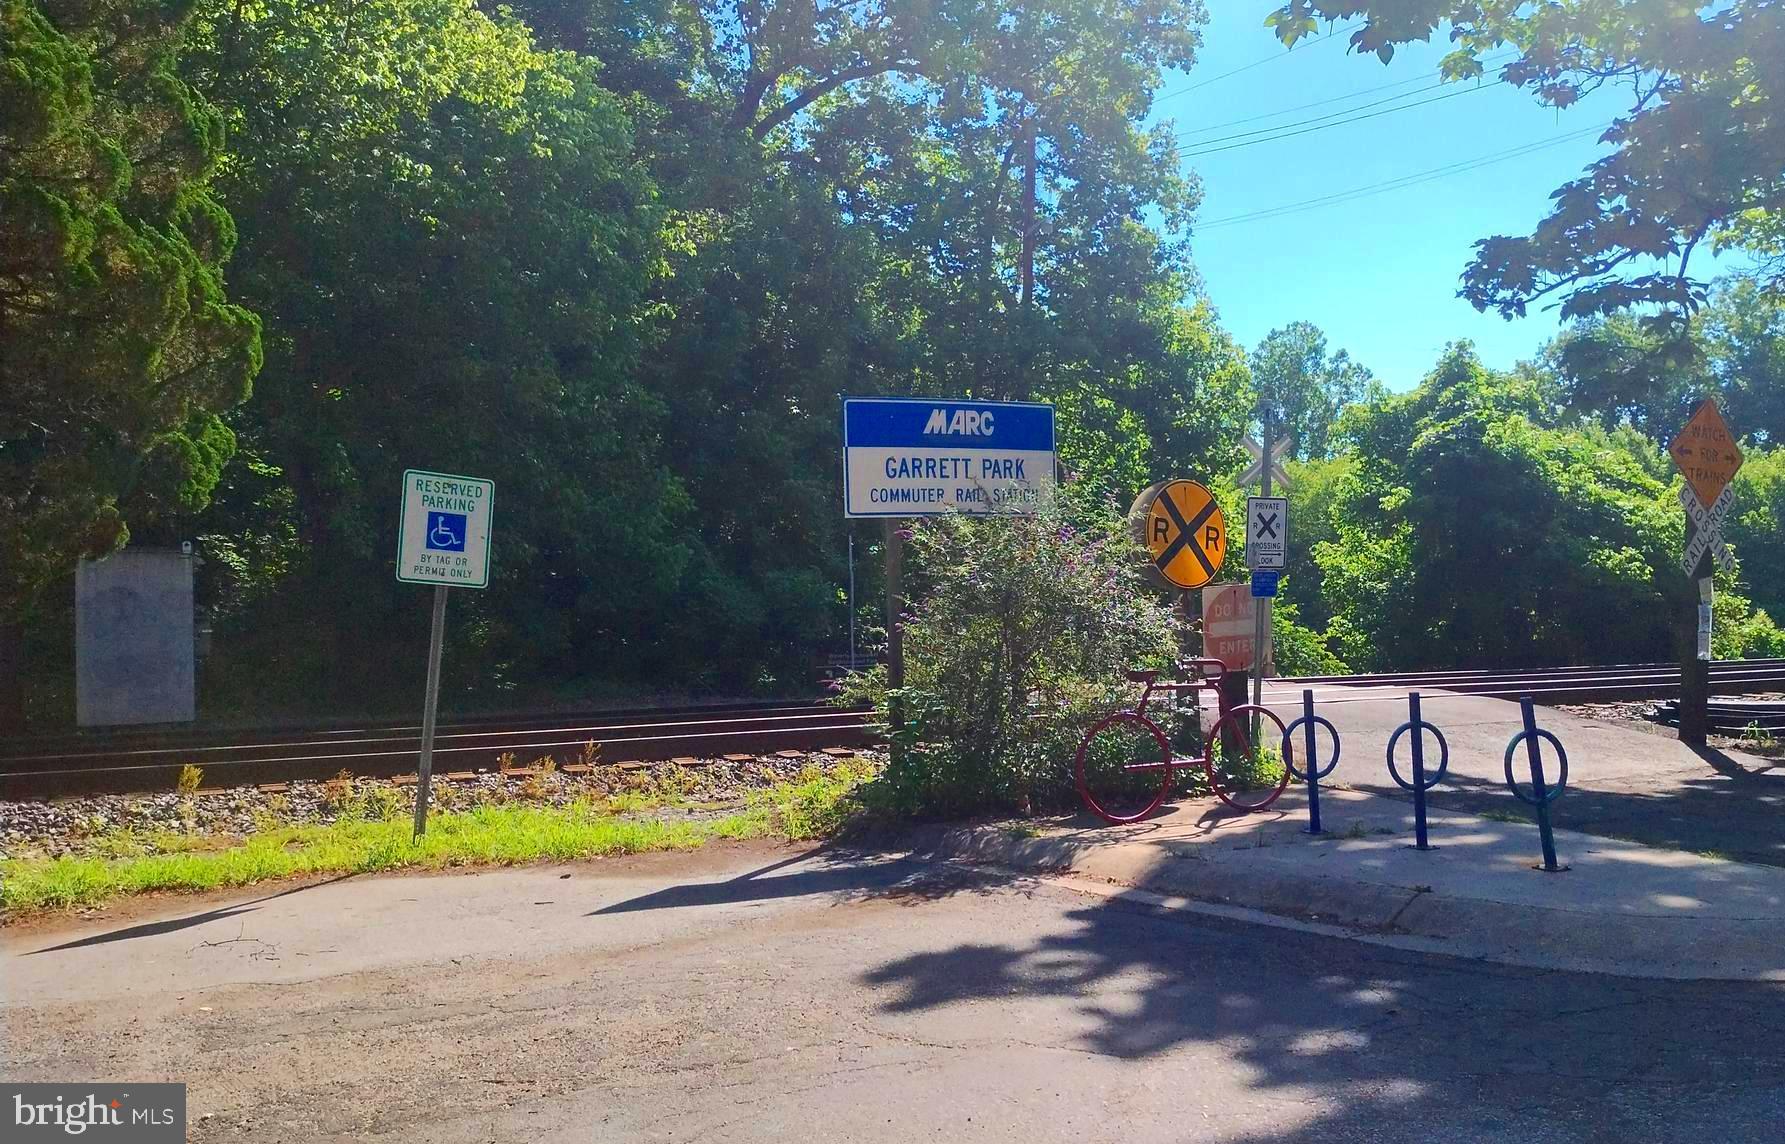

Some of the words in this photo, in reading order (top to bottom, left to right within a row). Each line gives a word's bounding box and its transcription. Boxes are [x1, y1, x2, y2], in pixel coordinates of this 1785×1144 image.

[923, 409, 995, 437] MARC
[1691, 424, 1726, 441] WATCH
[1701, 447, 1719, 462] FOR
[885, 457, 972, 479] GARRETT
[982, 458, 1026, 480] PARK
[1688, 467, 1727, 485] TRAINS
[416, 479, 482, 498] RESERVED
[870, 488, 945, 503] COMMUTER
[956, 488, 983, 503] RAIL
[422, 494, 475, 512] PARKING
[1255, 502, 1280, 511] PRIVATE
[1153, 516, 1169, 544] R
[1205, 525, 1220, 551] R
[1275, 522, 1281, 530] R
[1681, 488, 1733, 571] CROSSING
[420, 553, 431, 563] BY
[436, 555, 451, 565] TAG
[455, 557, 467, 566] OR
[413, 565, 446, 577] PERMIT
[450, 568, 472, 579] ONLY
[1215, 603, 1231, 617] DO
[1239, 602, 1256, 616] NO
